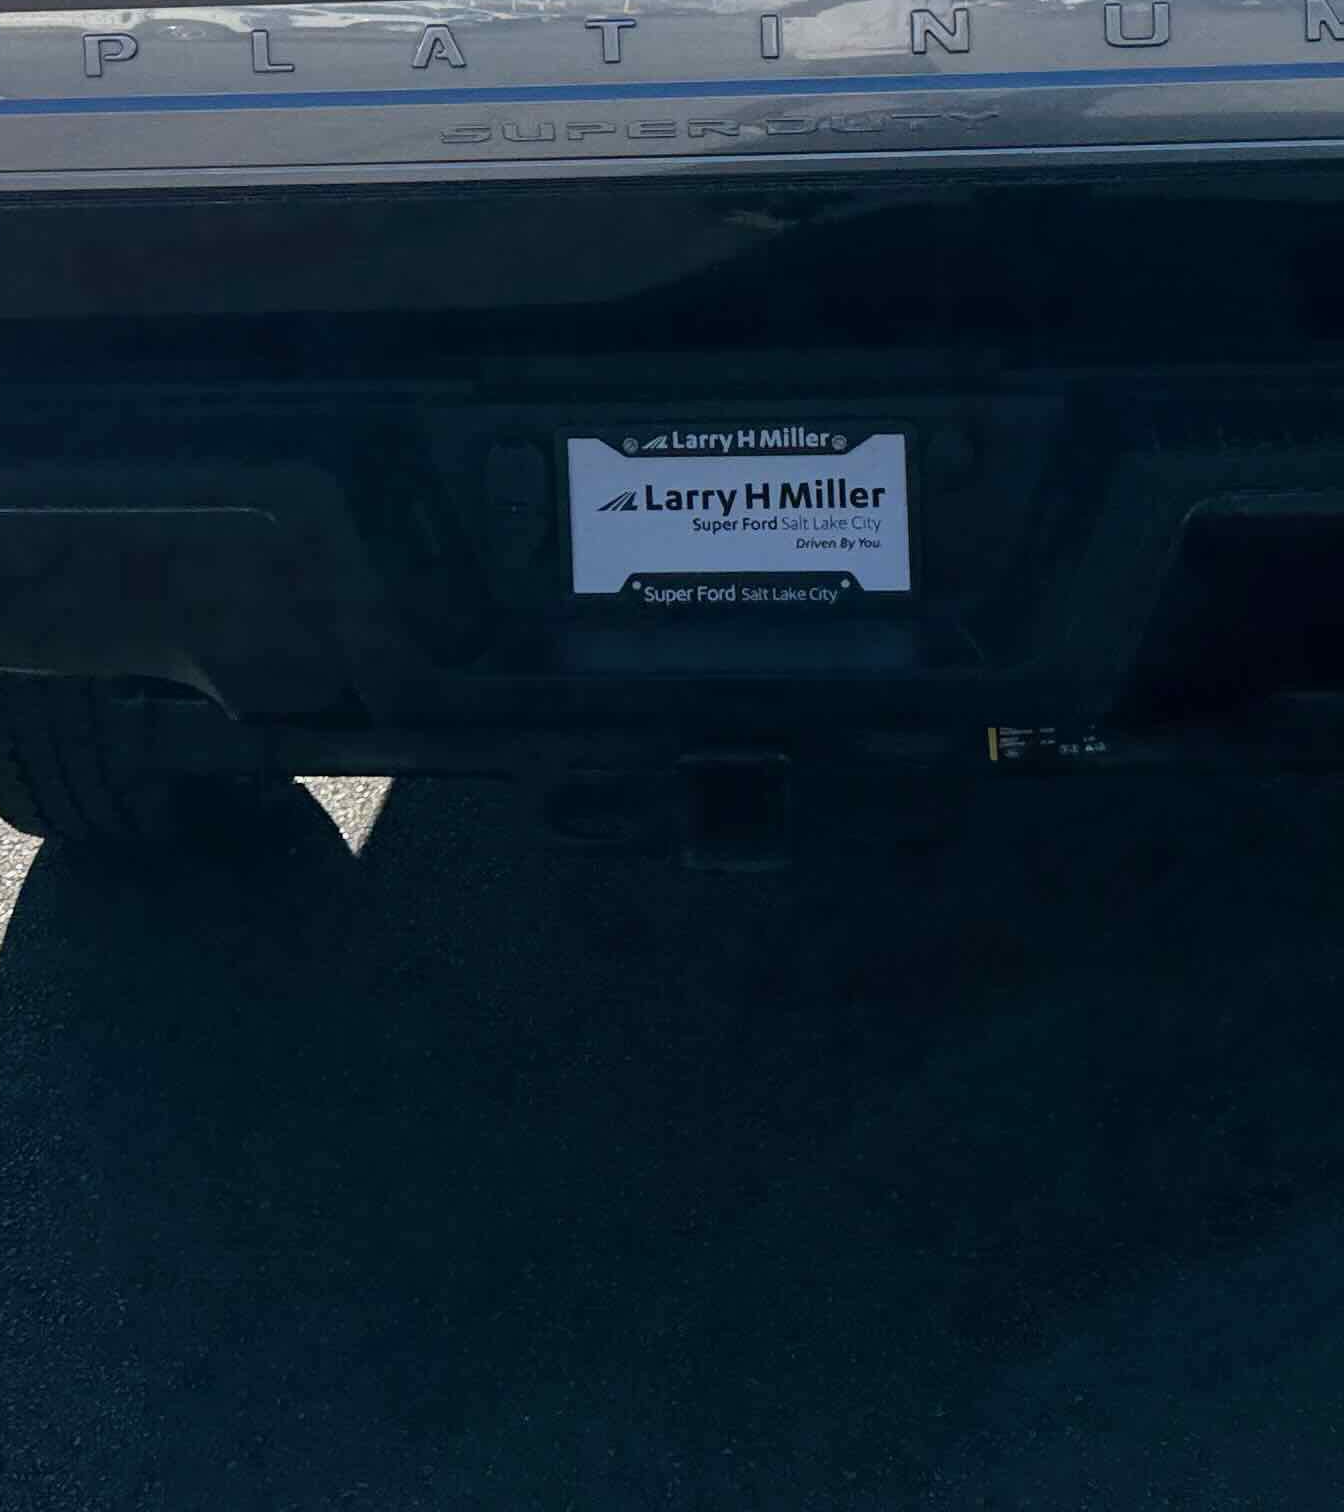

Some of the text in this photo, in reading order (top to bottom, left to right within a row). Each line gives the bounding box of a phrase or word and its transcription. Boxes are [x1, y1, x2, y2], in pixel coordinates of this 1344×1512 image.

[440, 110, 1000, 145] SUPER DUTY
[671, 426, 829, 452] Larry H Miller
[645, 478, 885, 516] Larry H Miller
[692, 516, 881, 535] Super Ford Salt Lake City
[795, 537, 881, 551] Driven By You
[644, 586, 838, 606] Super Ford Salt Lake City
